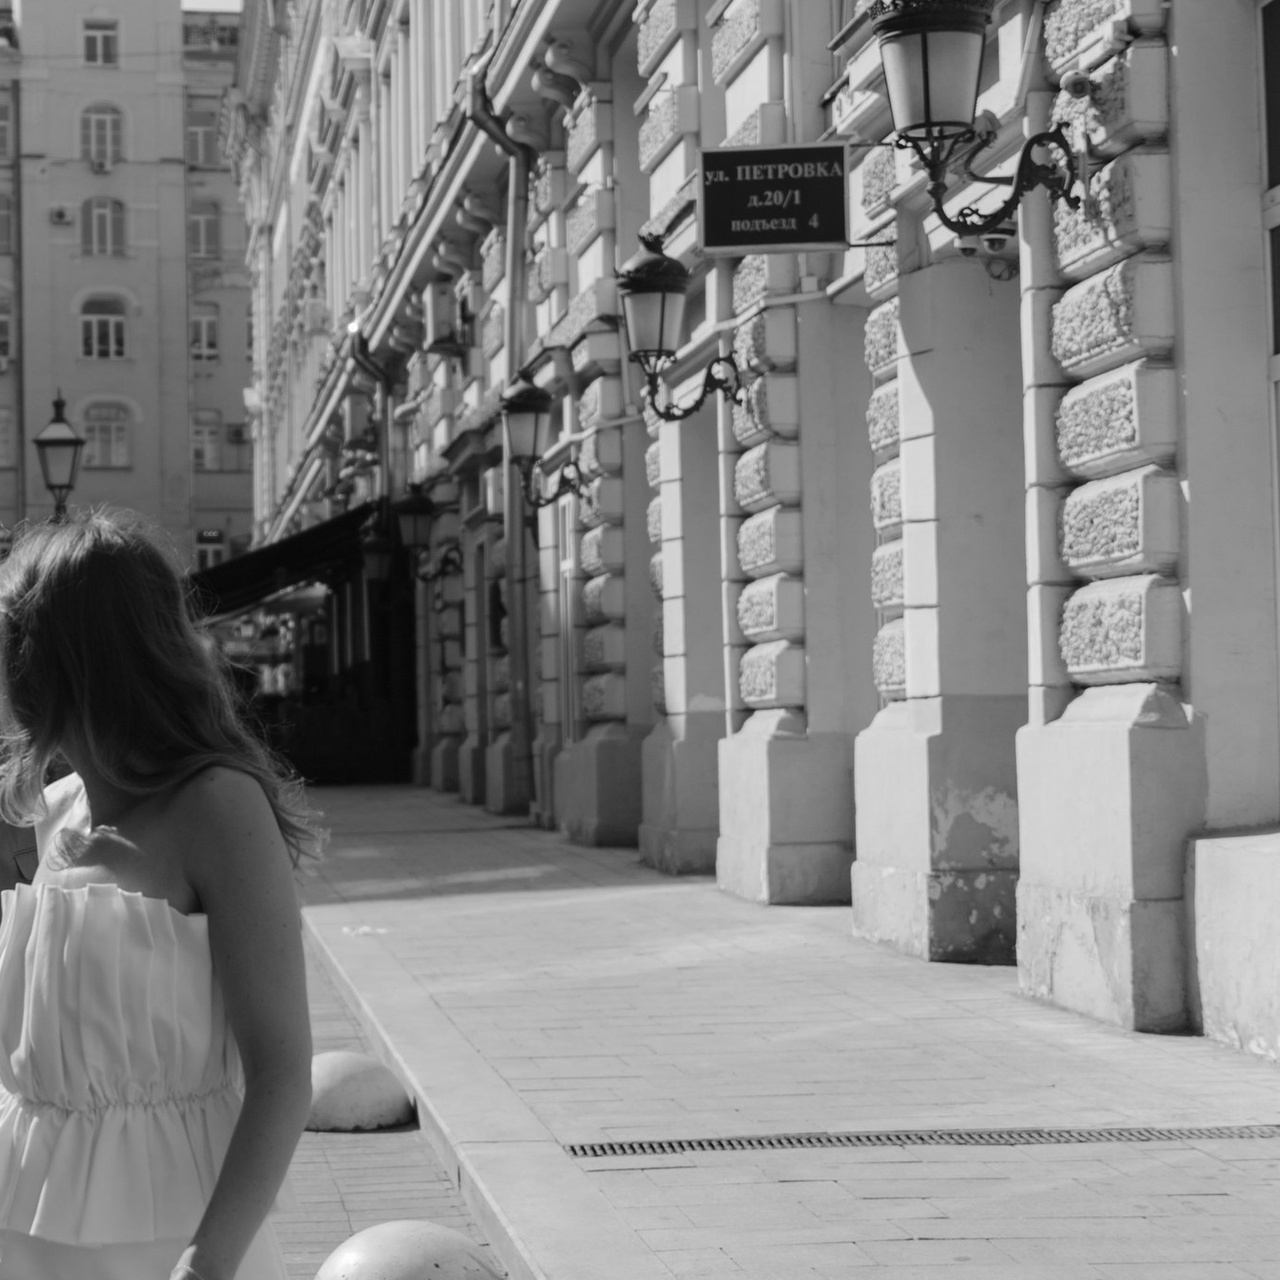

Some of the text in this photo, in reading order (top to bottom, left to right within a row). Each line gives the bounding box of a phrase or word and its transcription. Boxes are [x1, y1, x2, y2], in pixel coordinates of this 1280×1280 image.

[705, 161, 842, 185] ул. ПЕТРОВКА
[747, 189, 801, 208] д.20/1
[731, 213, 819, 232] подъезд 4
